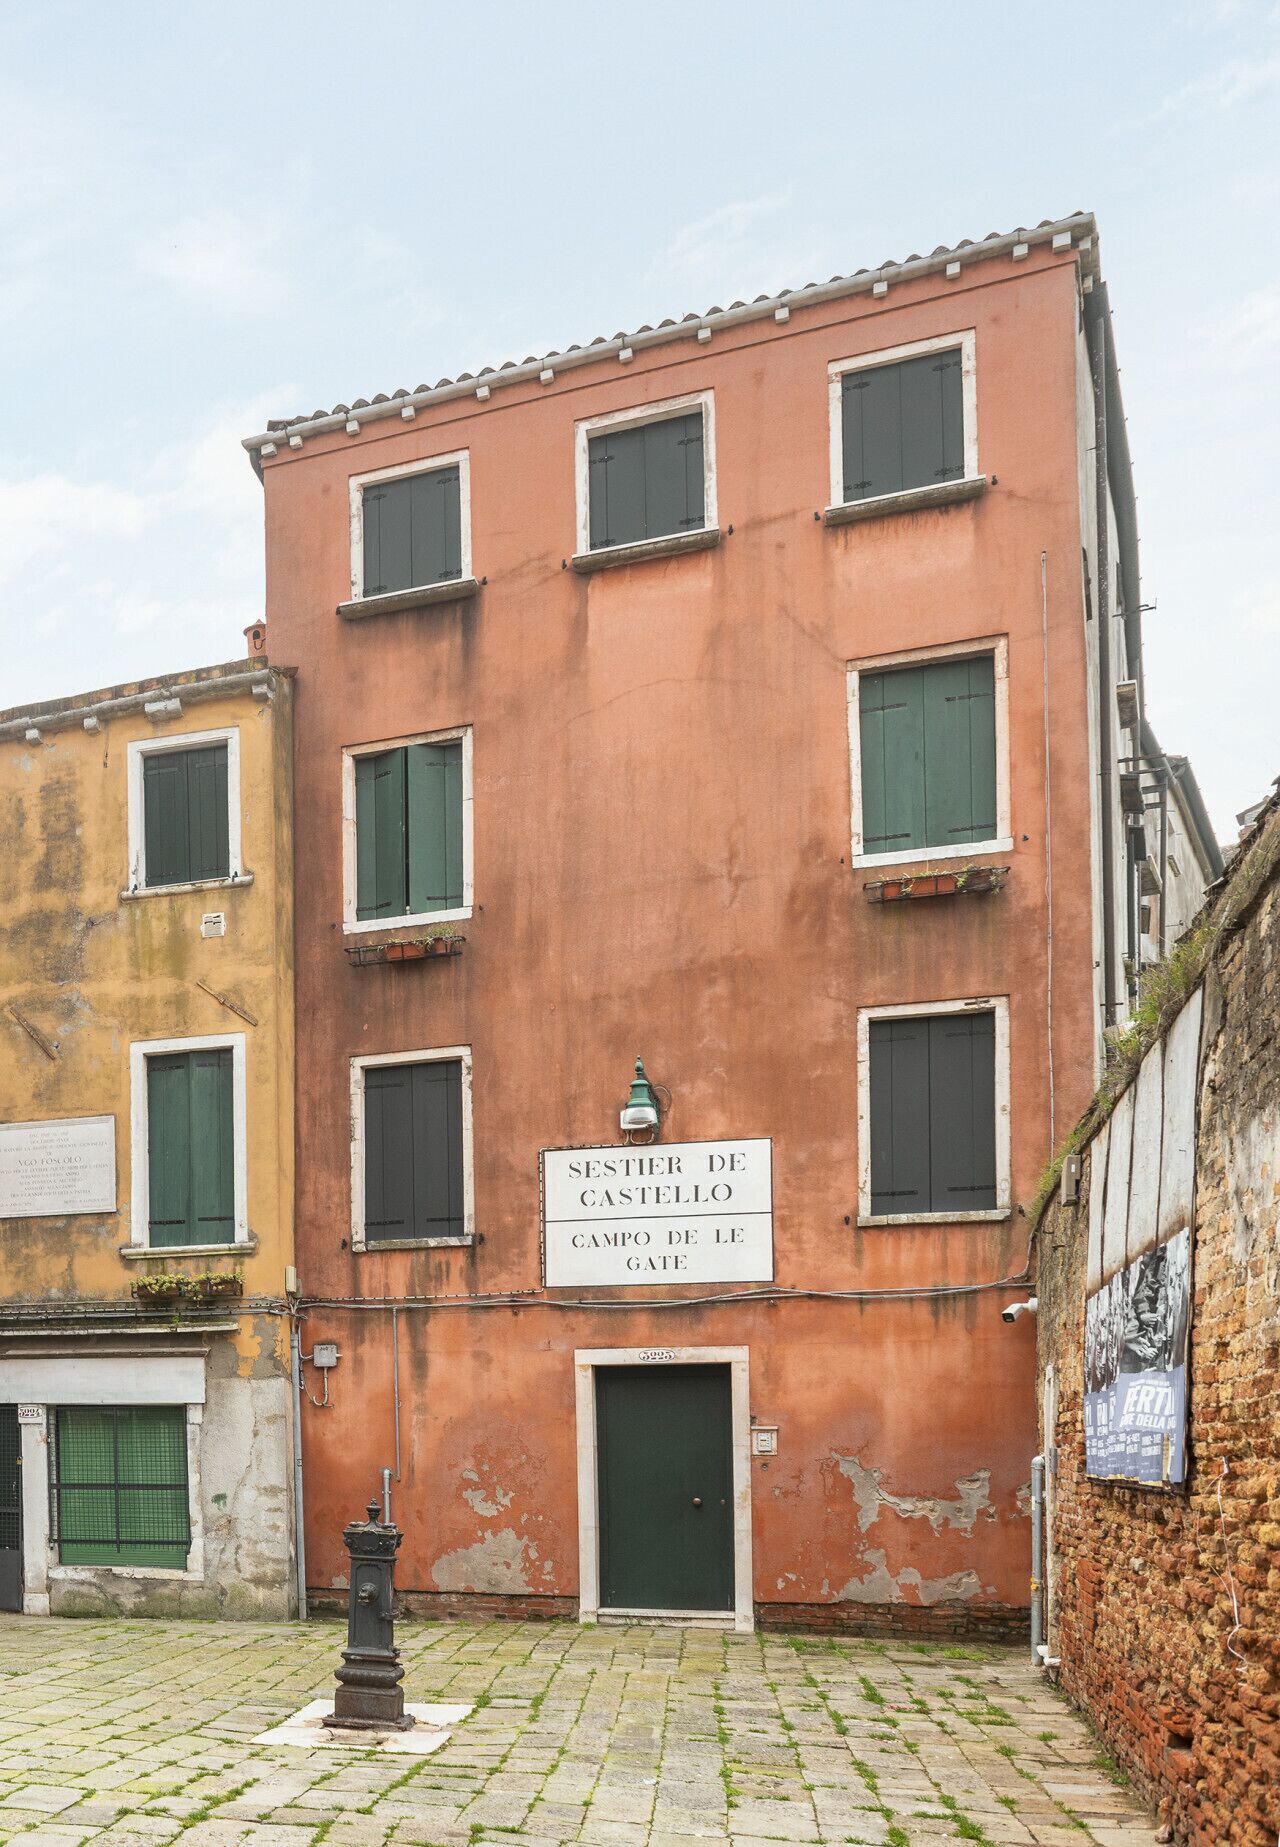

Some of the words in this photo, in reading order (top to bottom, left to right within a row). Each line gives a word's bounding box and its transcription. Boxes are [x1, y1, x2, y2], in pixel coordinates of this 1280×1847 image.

[41, 1155, 82, 1165] FOSCOLO
[568, 1155, 683, 1179] SESTIER
[707, 1152, 747, 1173] DE
[580, 1182, 733, 1207] CASTELLO
[571, 1230, 651, 1249] CAMPO
[667, 1229, 698, 1245] DE
[714, 1227, 745, 1244] LE
[626, 1254, 688, 1271] GATE
